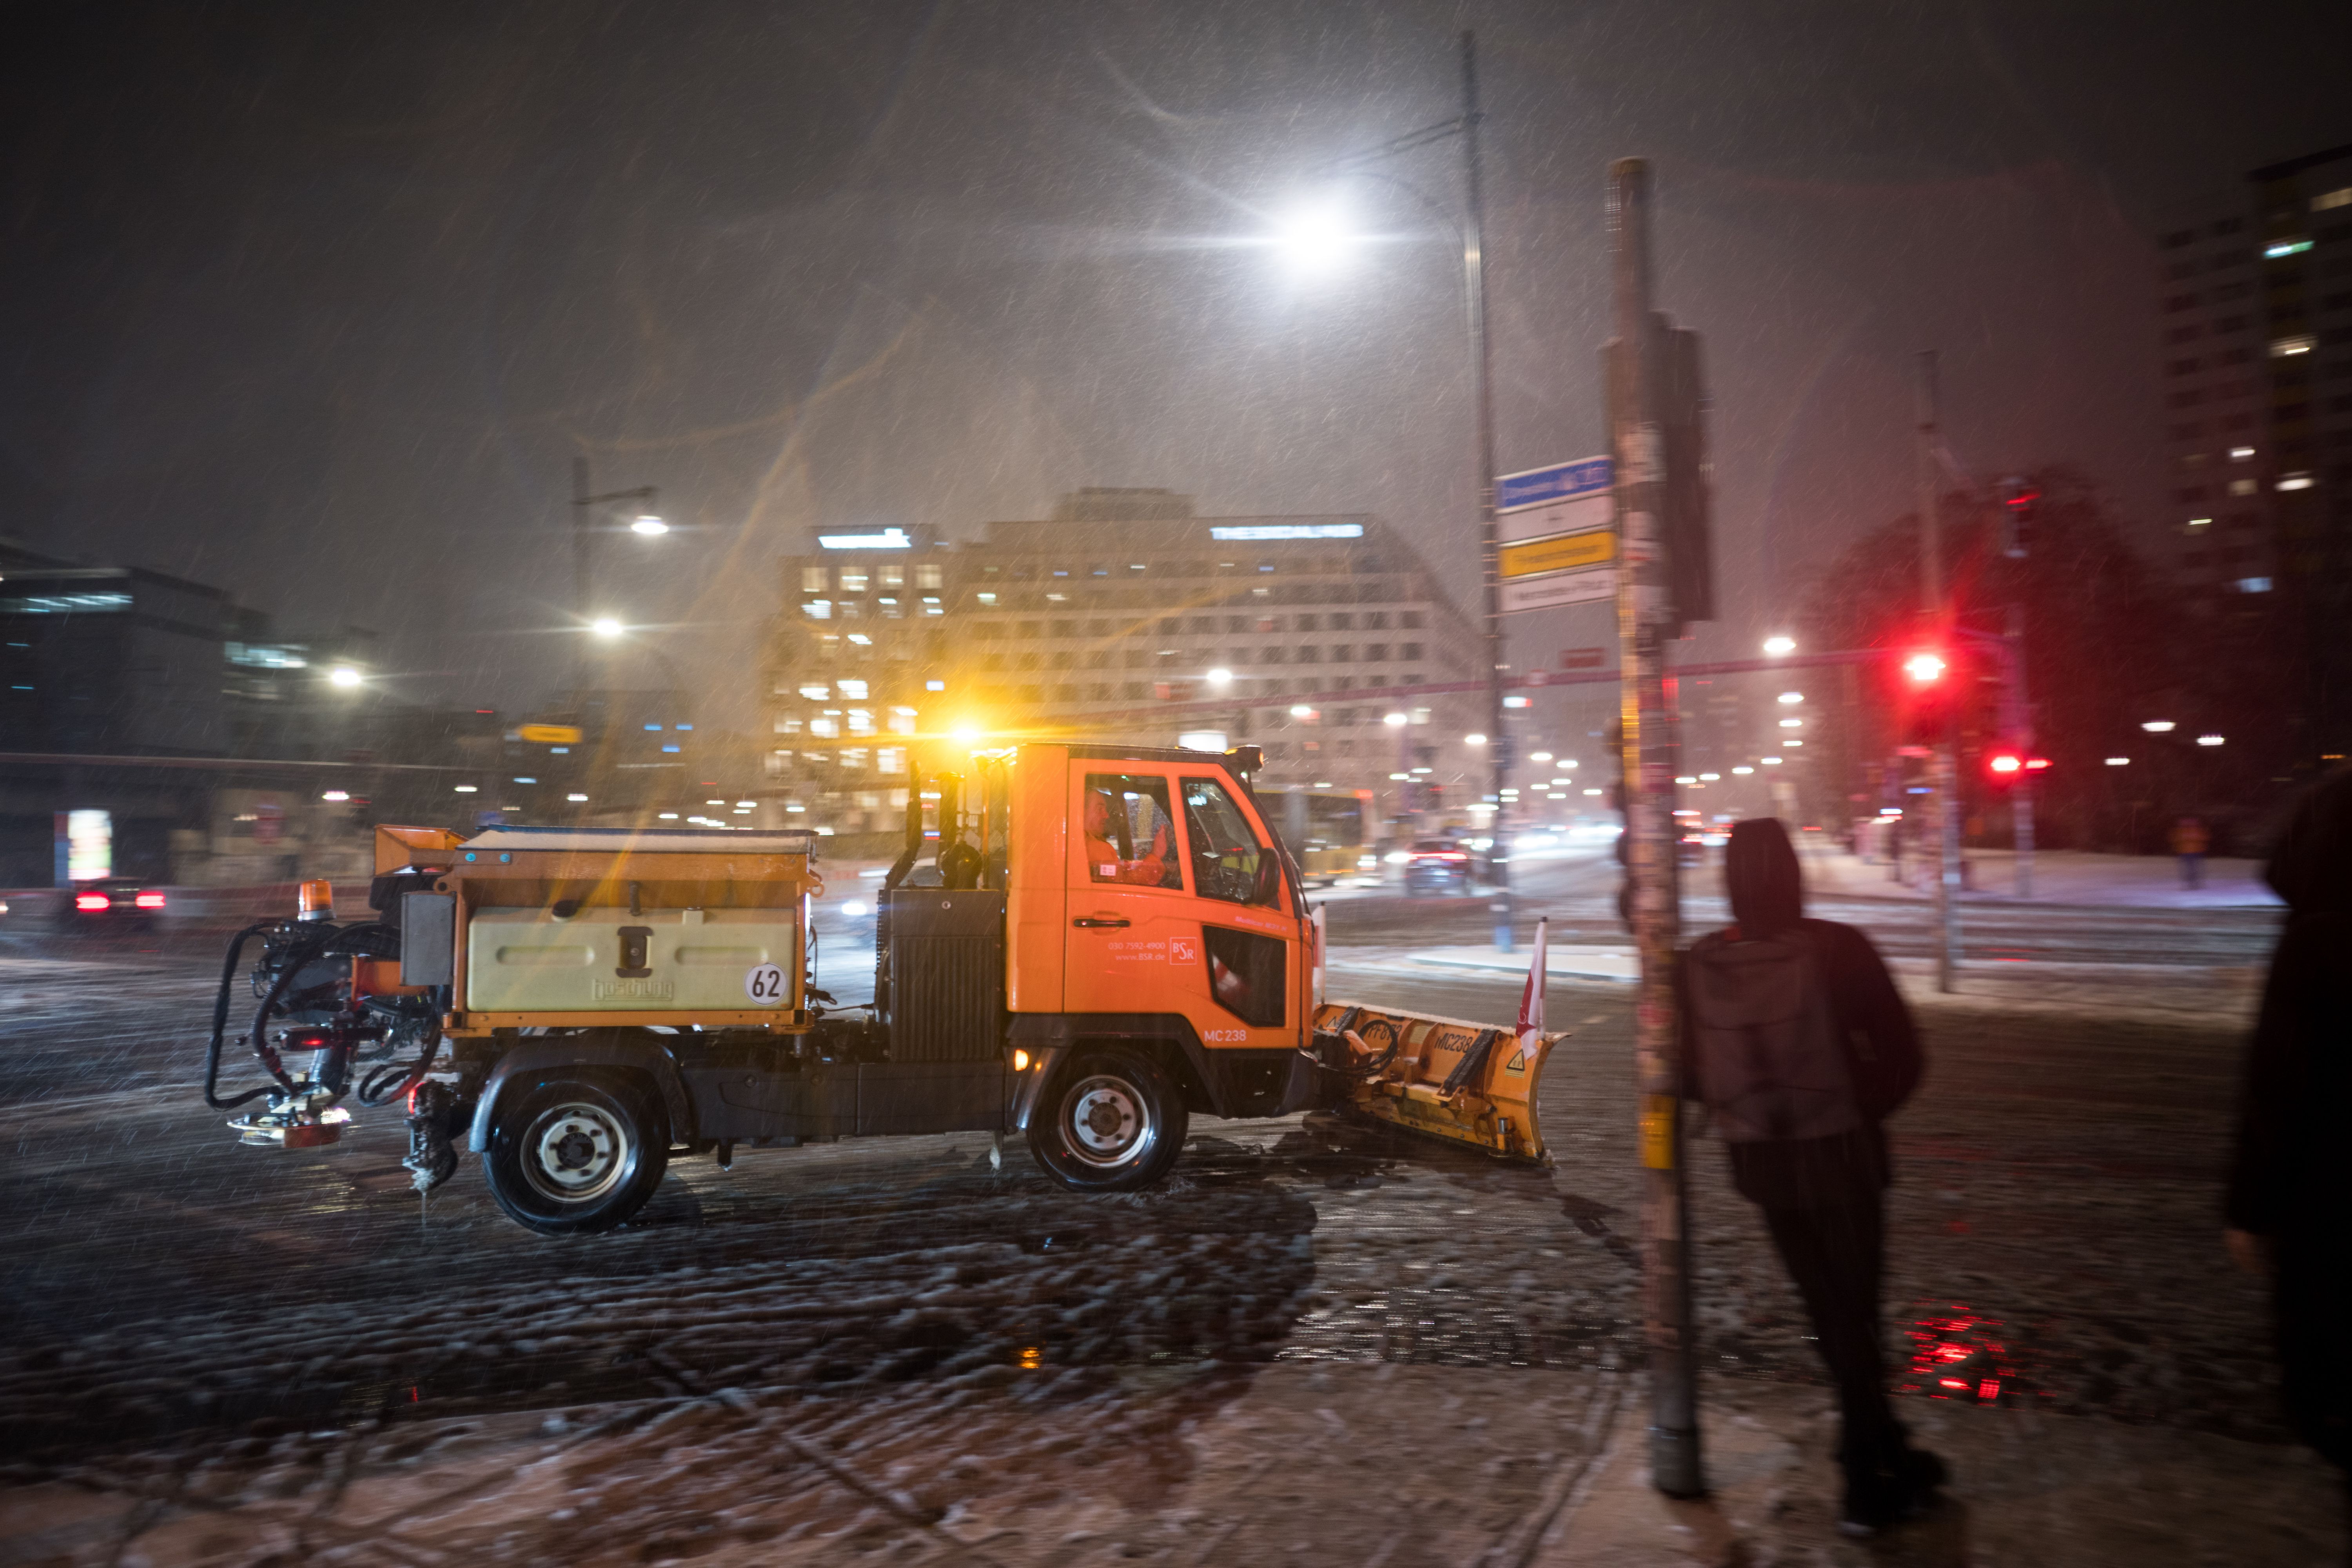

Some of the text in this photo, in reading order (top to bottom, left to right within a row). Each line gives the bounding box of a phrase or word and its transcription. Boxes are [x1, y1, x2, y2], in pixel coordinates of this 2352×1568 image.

[1172, 942, 1194, 960] BSR
[753, 970, 780, 998] 62
[1434, 1033, 1473, 1054] MC238
